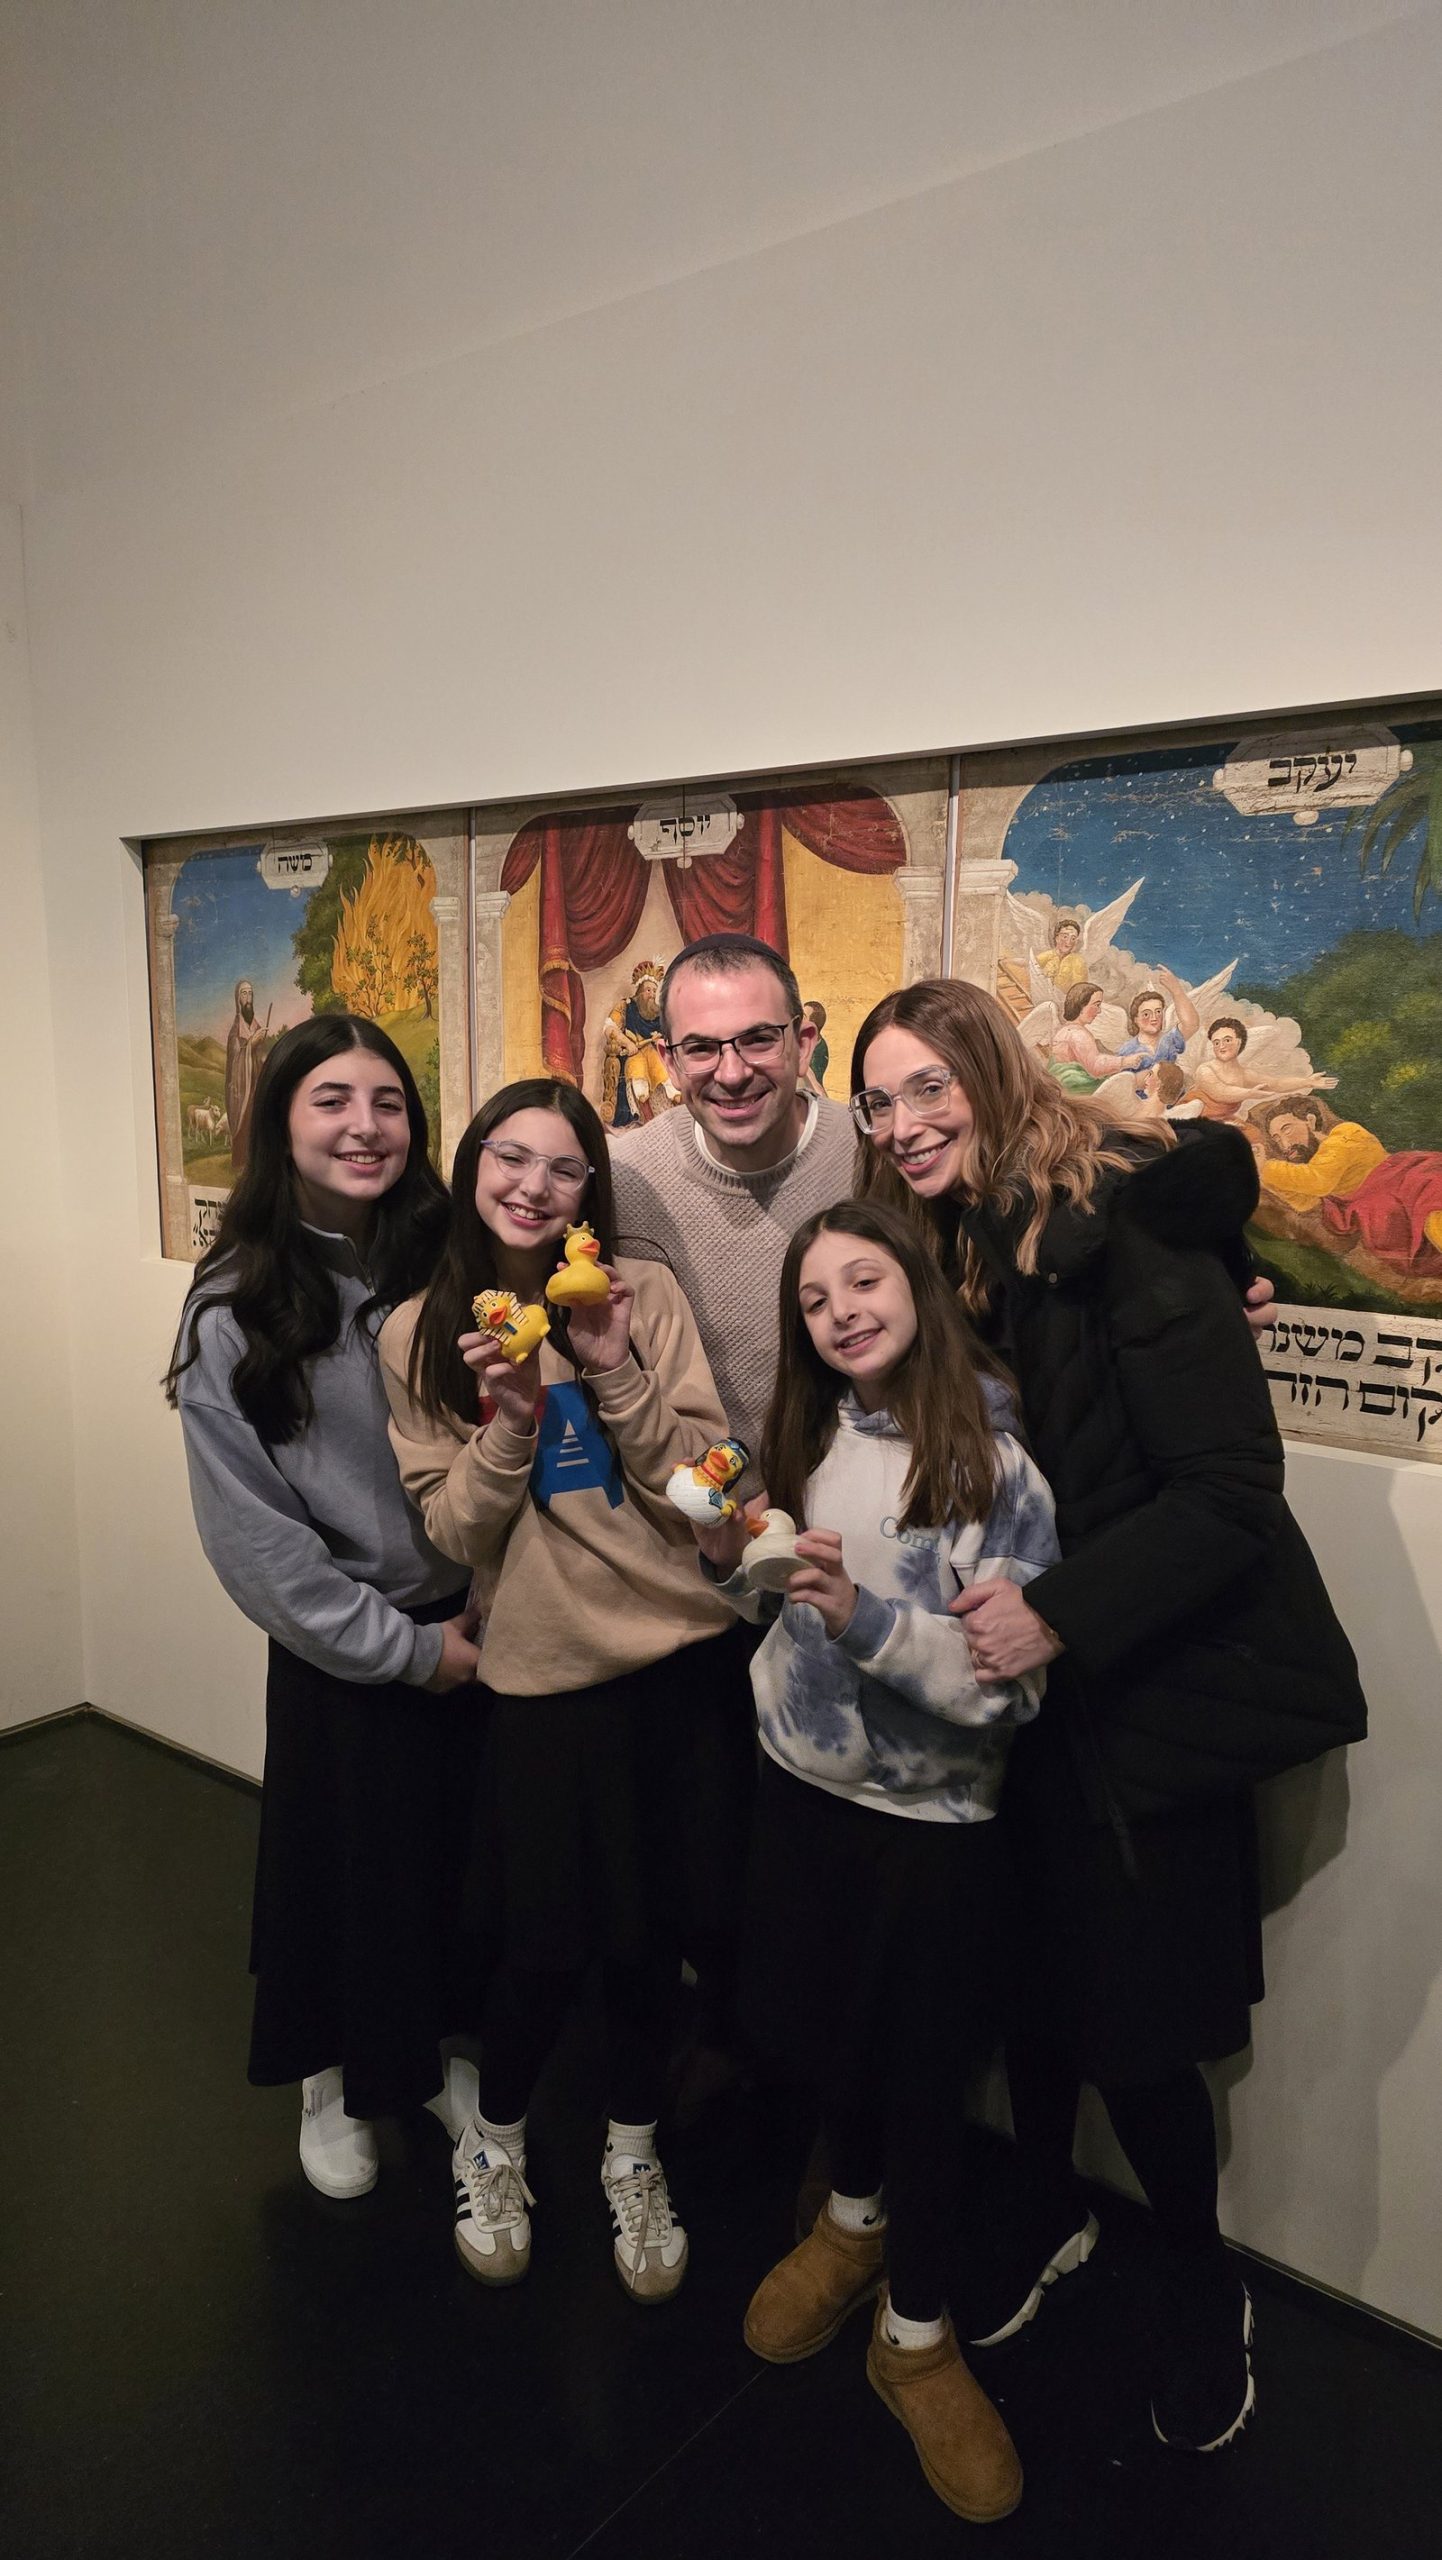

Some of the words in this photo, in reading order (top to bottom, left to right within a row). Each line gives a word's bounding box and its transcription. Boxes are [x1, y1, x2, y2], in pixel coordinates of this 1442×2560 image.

[1268, 753, 1357, 793] יעקב
[660, 814, 710, 845] יוסף
[278, 853, 312, 873] משה
